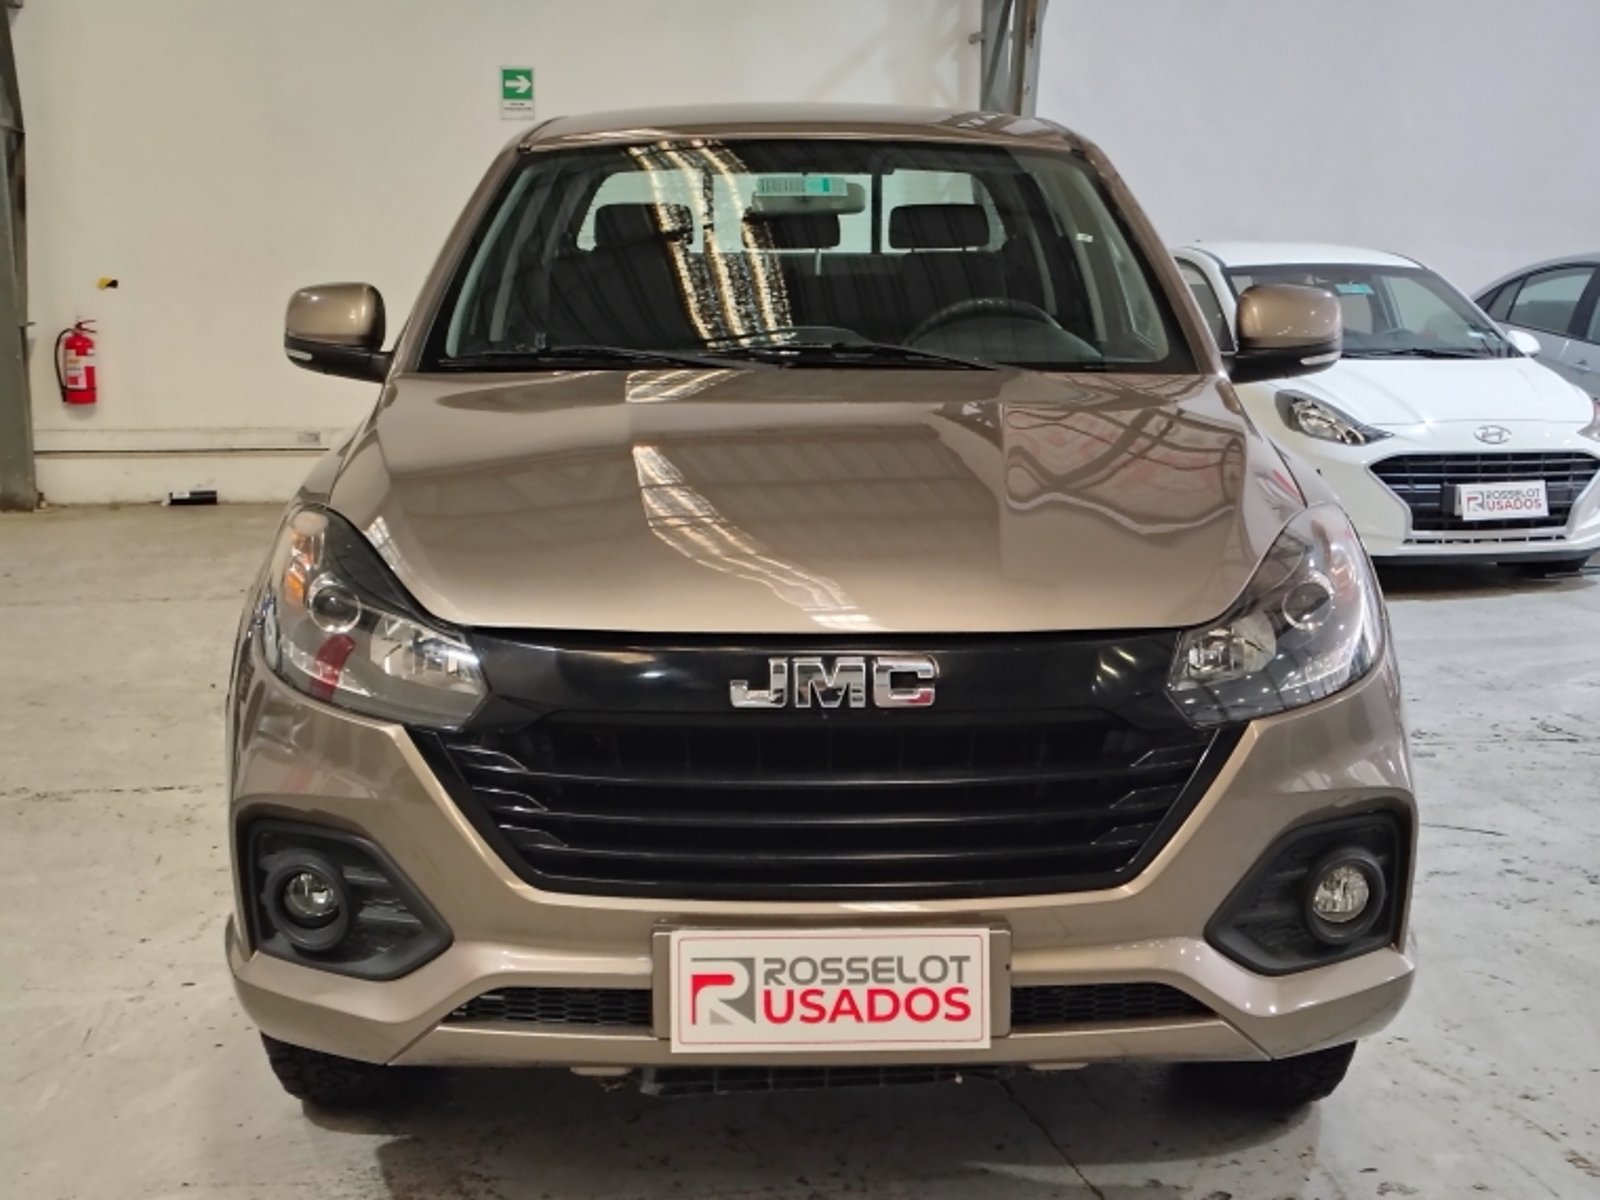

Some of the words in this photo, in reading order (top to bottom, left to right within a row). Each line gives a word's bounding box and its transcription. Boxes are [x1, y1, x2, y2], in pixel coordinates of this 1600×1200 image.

[1486, 498, 1542, 511] USADOS
[730, 656, 938, 708] JMC
[763, 955, 972, 986] ROSSELOT
[763, 986, 972, 1025] USADOS
